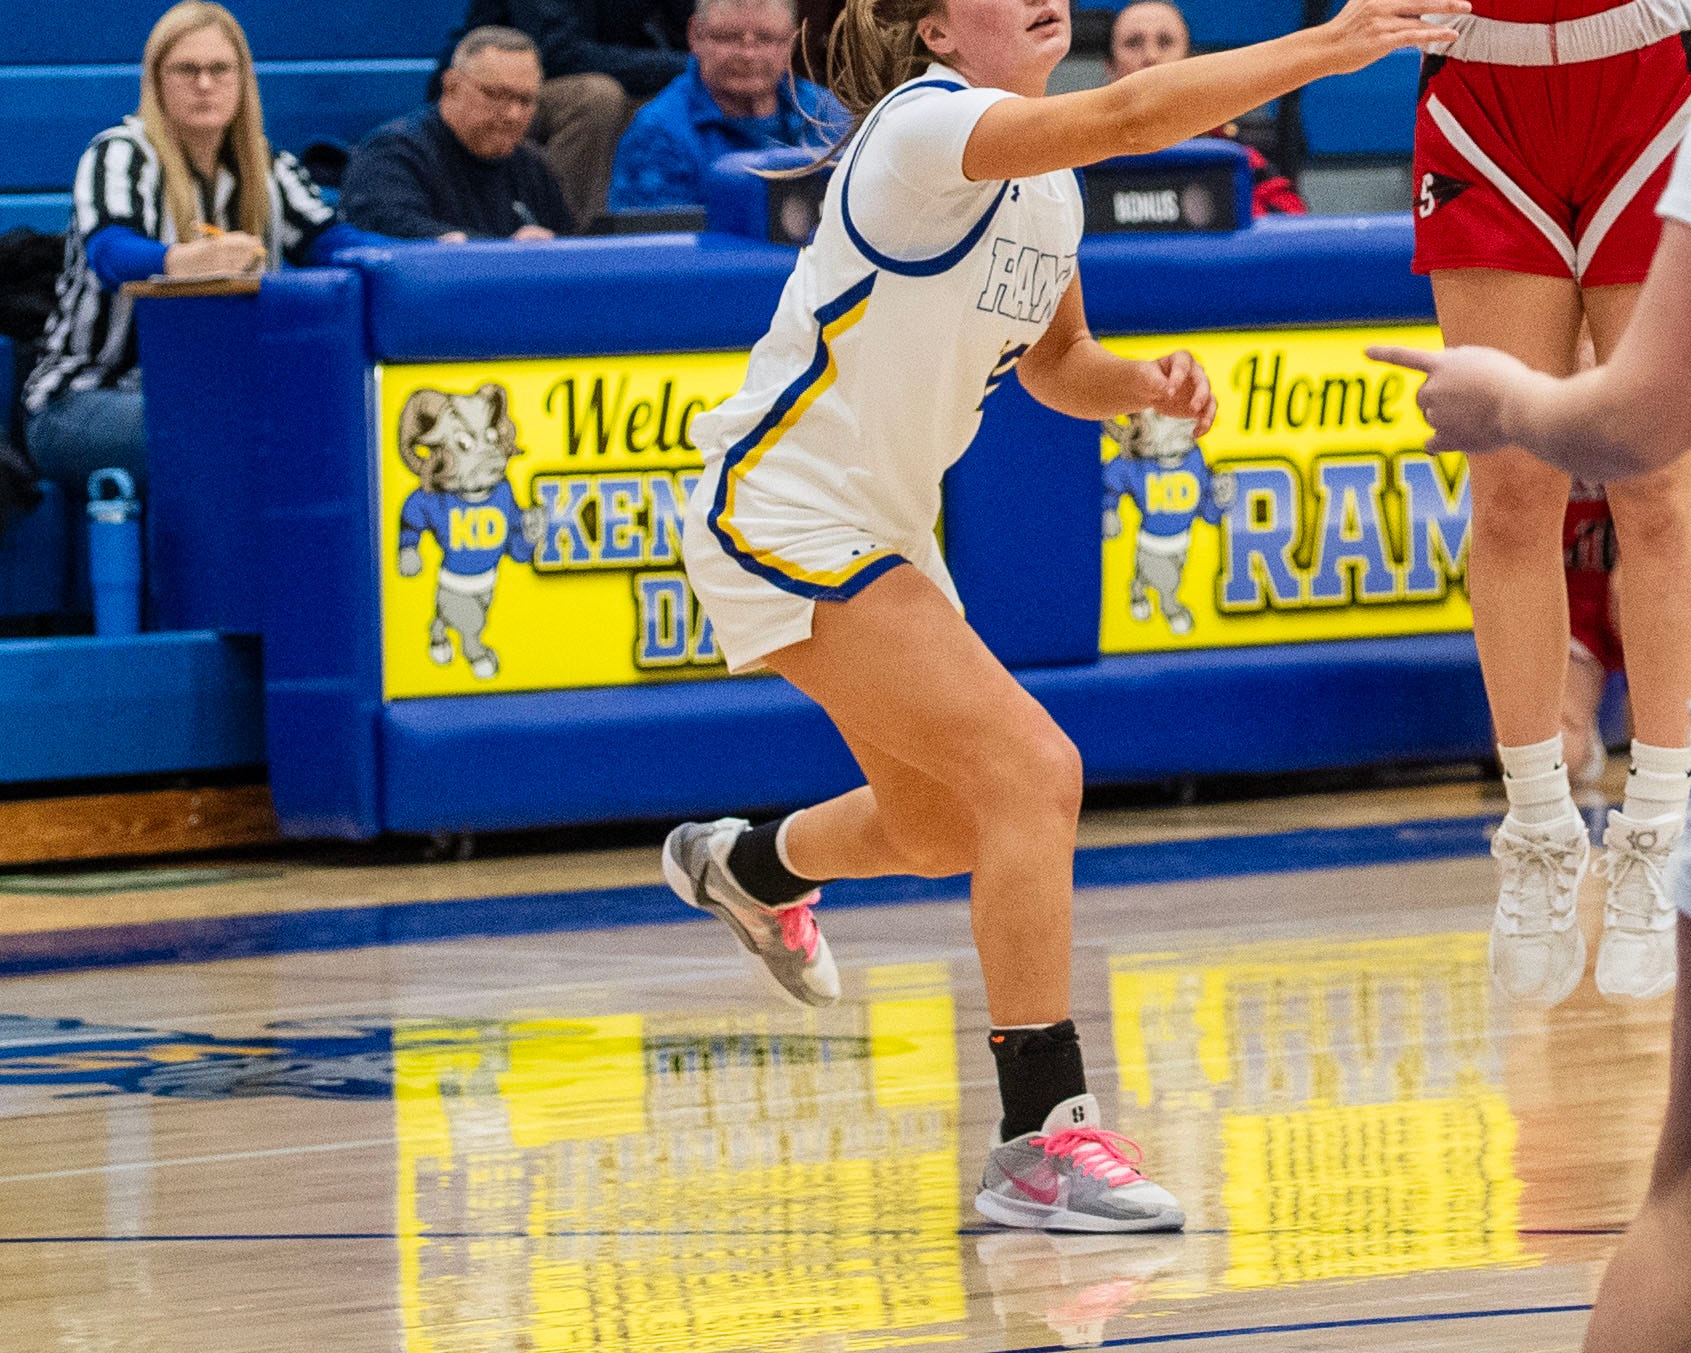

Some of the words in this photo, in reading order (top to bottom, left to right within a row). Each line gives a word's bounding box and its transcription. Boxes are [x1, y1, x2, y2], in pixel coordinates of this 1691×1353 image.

[1112, 188, 1181, 224] BONUS
[976, 236, 1079, 325] RAM
[545, 375, 706, 457] Welc
[1231, 350, 1404, 432] Home
[449, 505, 508, 551] KD
[1145, 470, 1200, 515] KD
[1220, 456, 1474, 606] RAM
